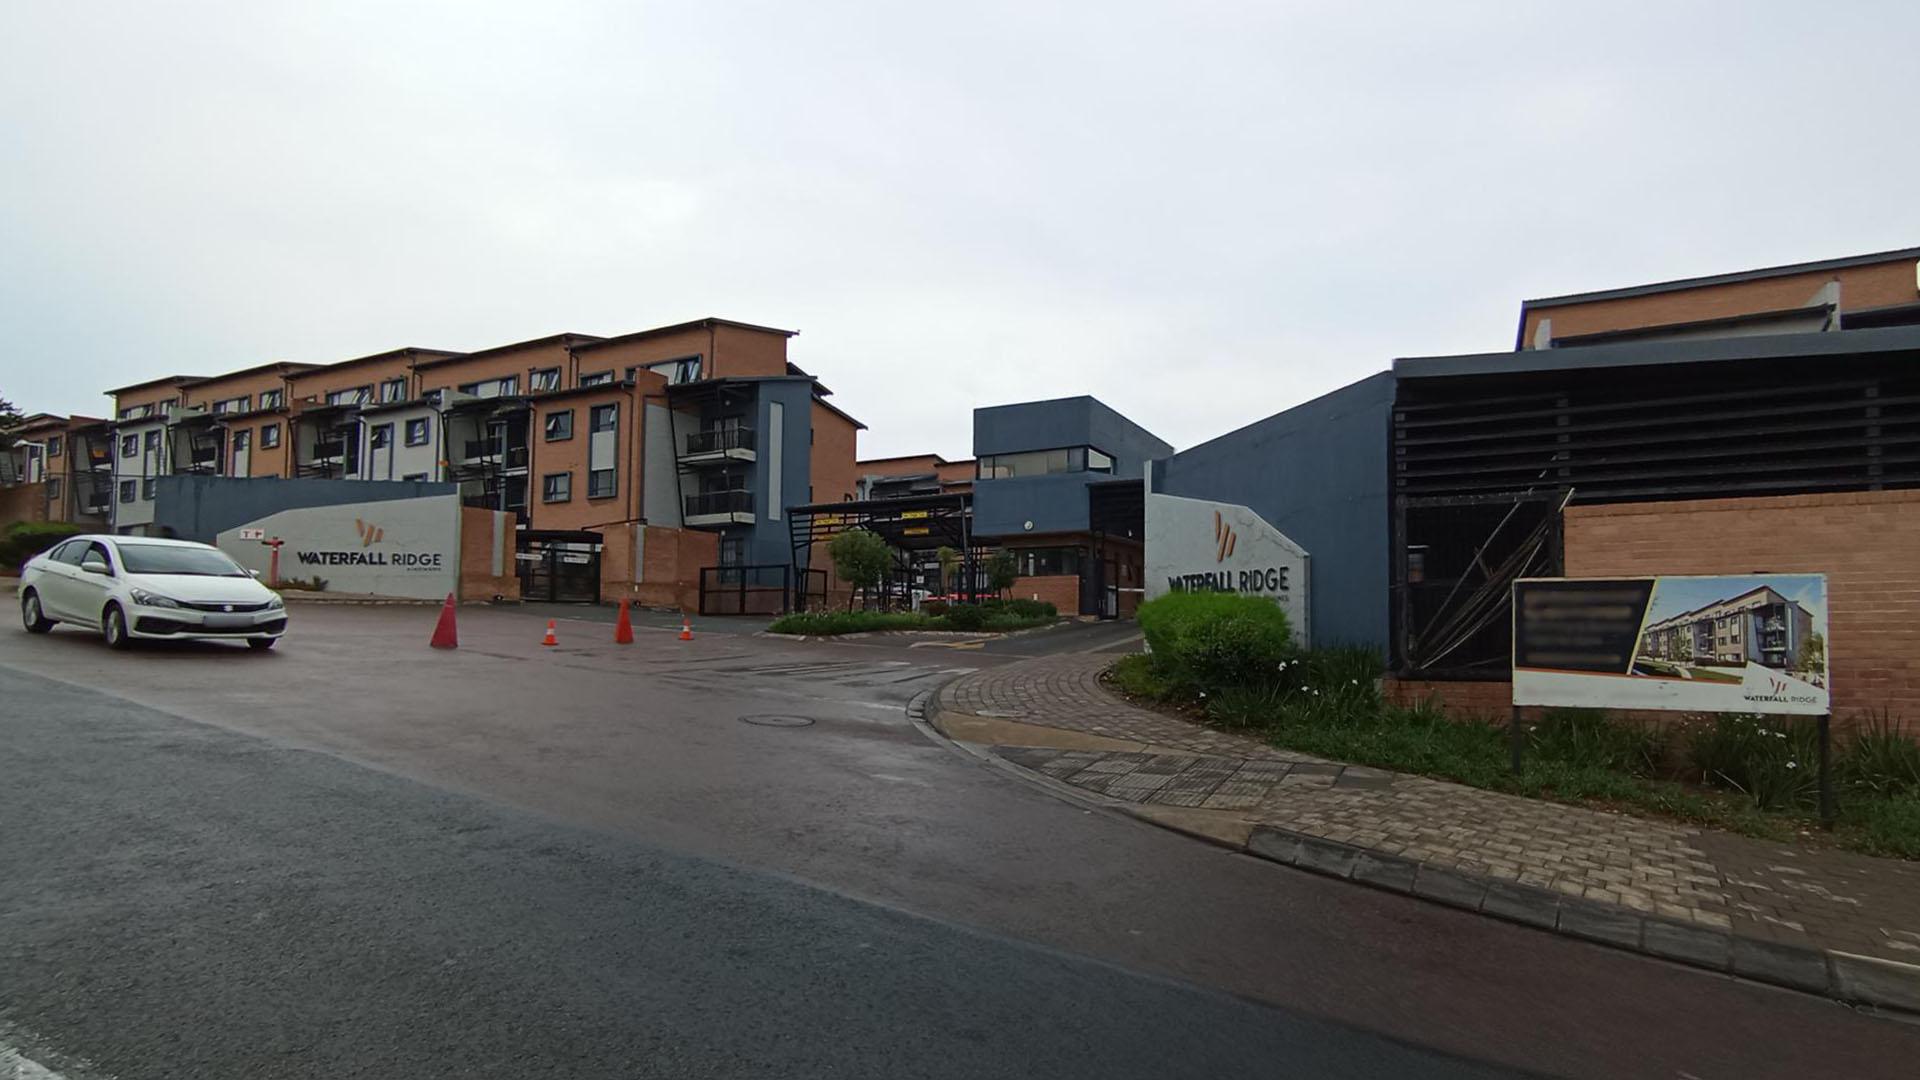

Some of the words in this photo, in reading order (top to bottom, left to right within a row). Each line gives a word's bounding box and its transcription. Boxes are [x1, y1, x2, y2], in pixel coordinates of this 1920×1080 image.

[298, 551, 387, 565] WATERFALL
[392, 553, 441, 566] RIDGE
[1240, 566, 1289, 592] RIDGE
